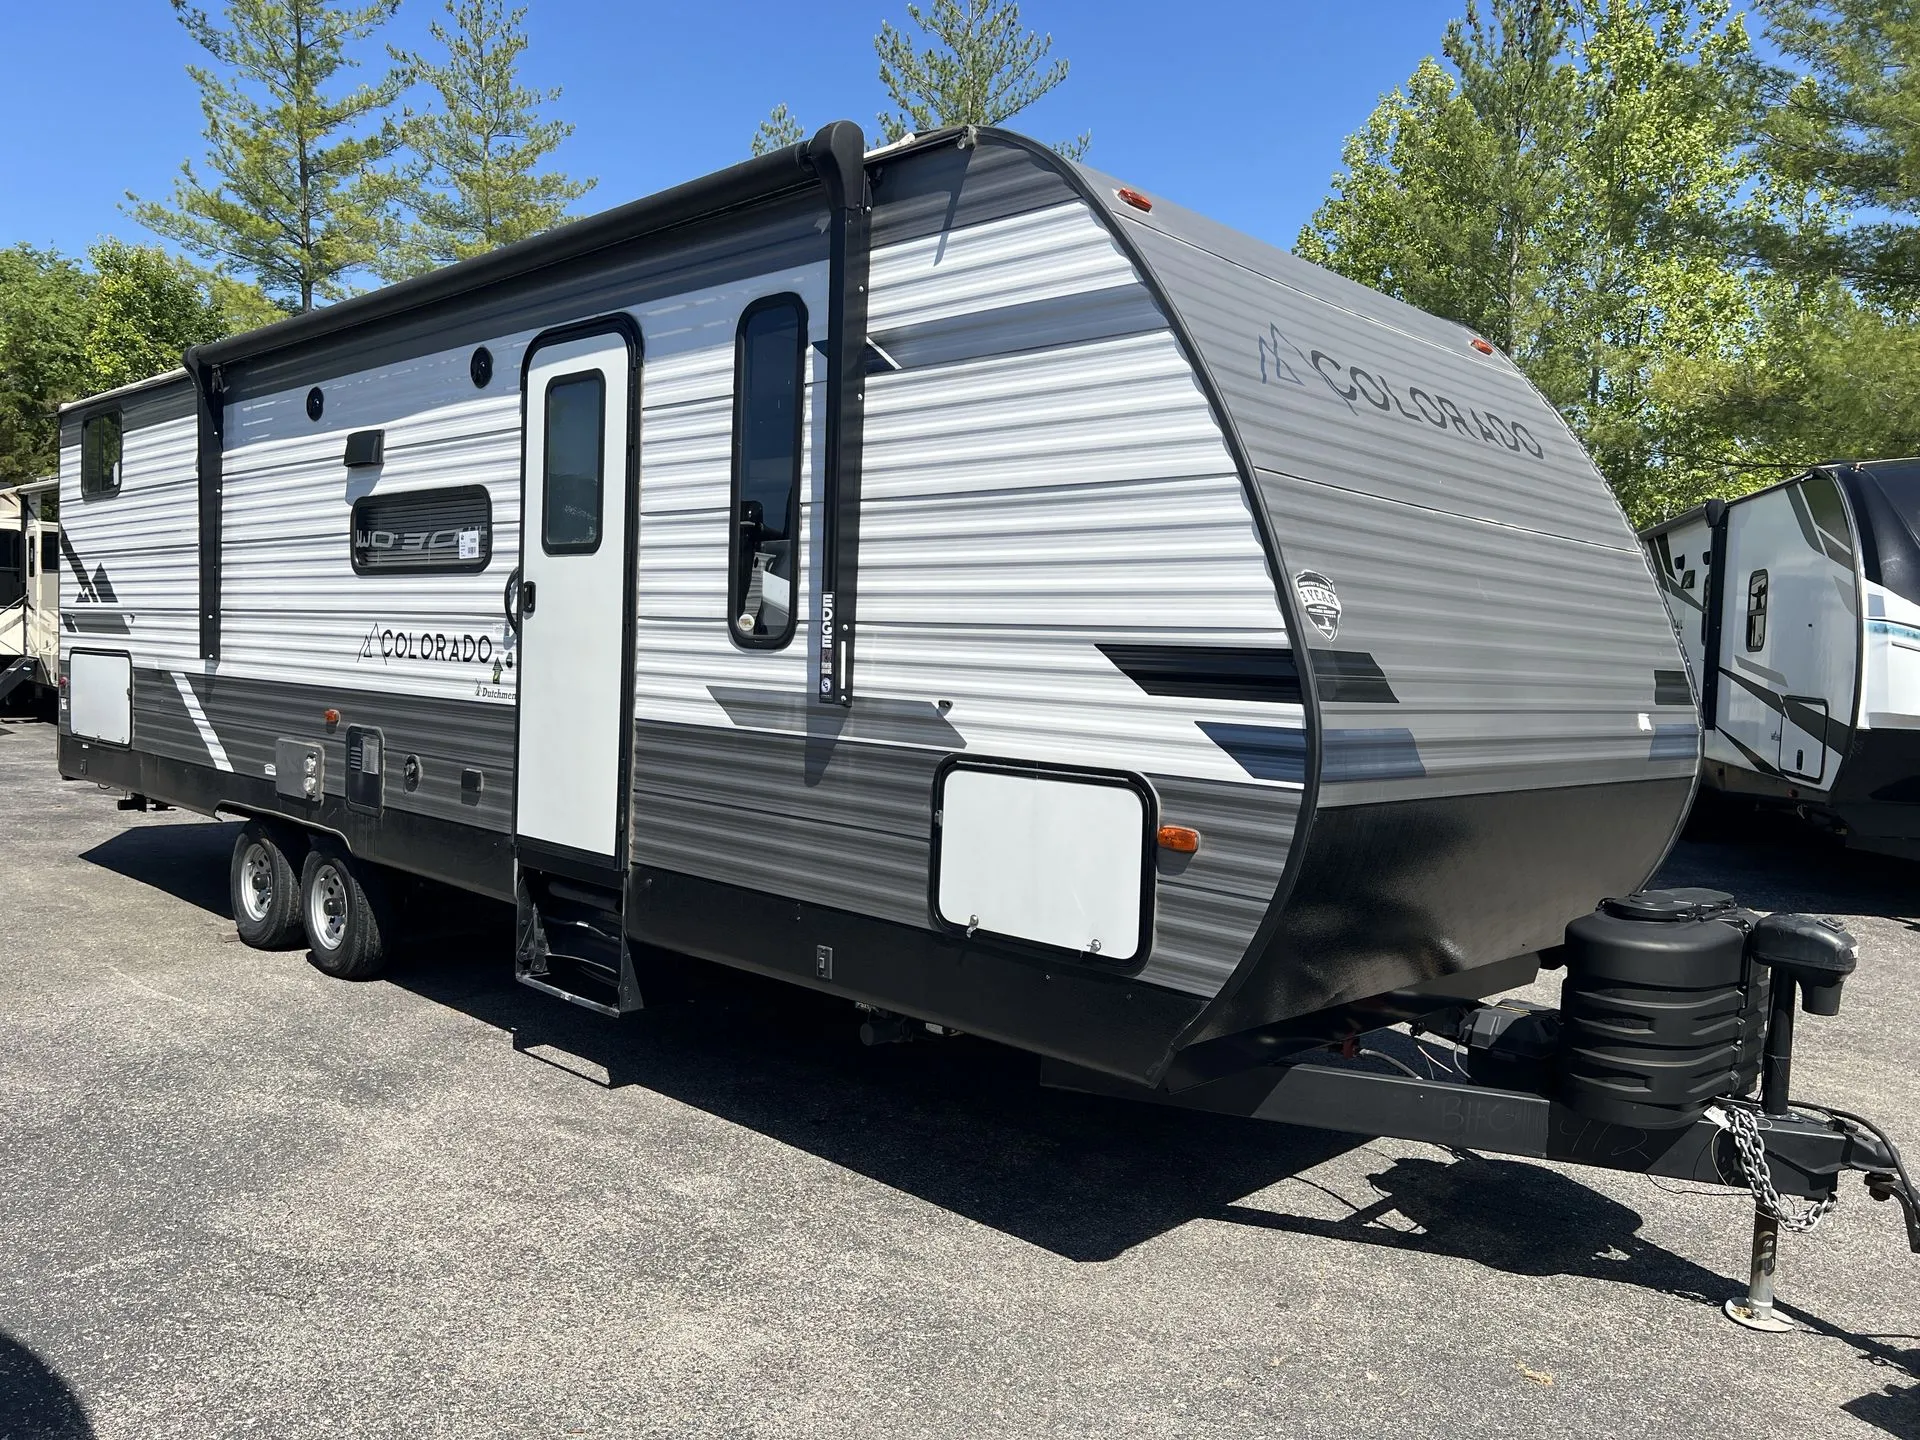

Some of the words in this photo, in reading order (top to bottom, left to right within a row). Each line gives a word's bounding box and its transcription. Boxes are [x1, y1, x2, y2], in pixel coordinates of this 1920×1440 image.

[1311, 350, 1545, 460] COLORADO
[1307, 589, 1338, 606] YEAR
[821, 593, 833, 648] EDGE
[382, 629, 493, 663] COLORADO
